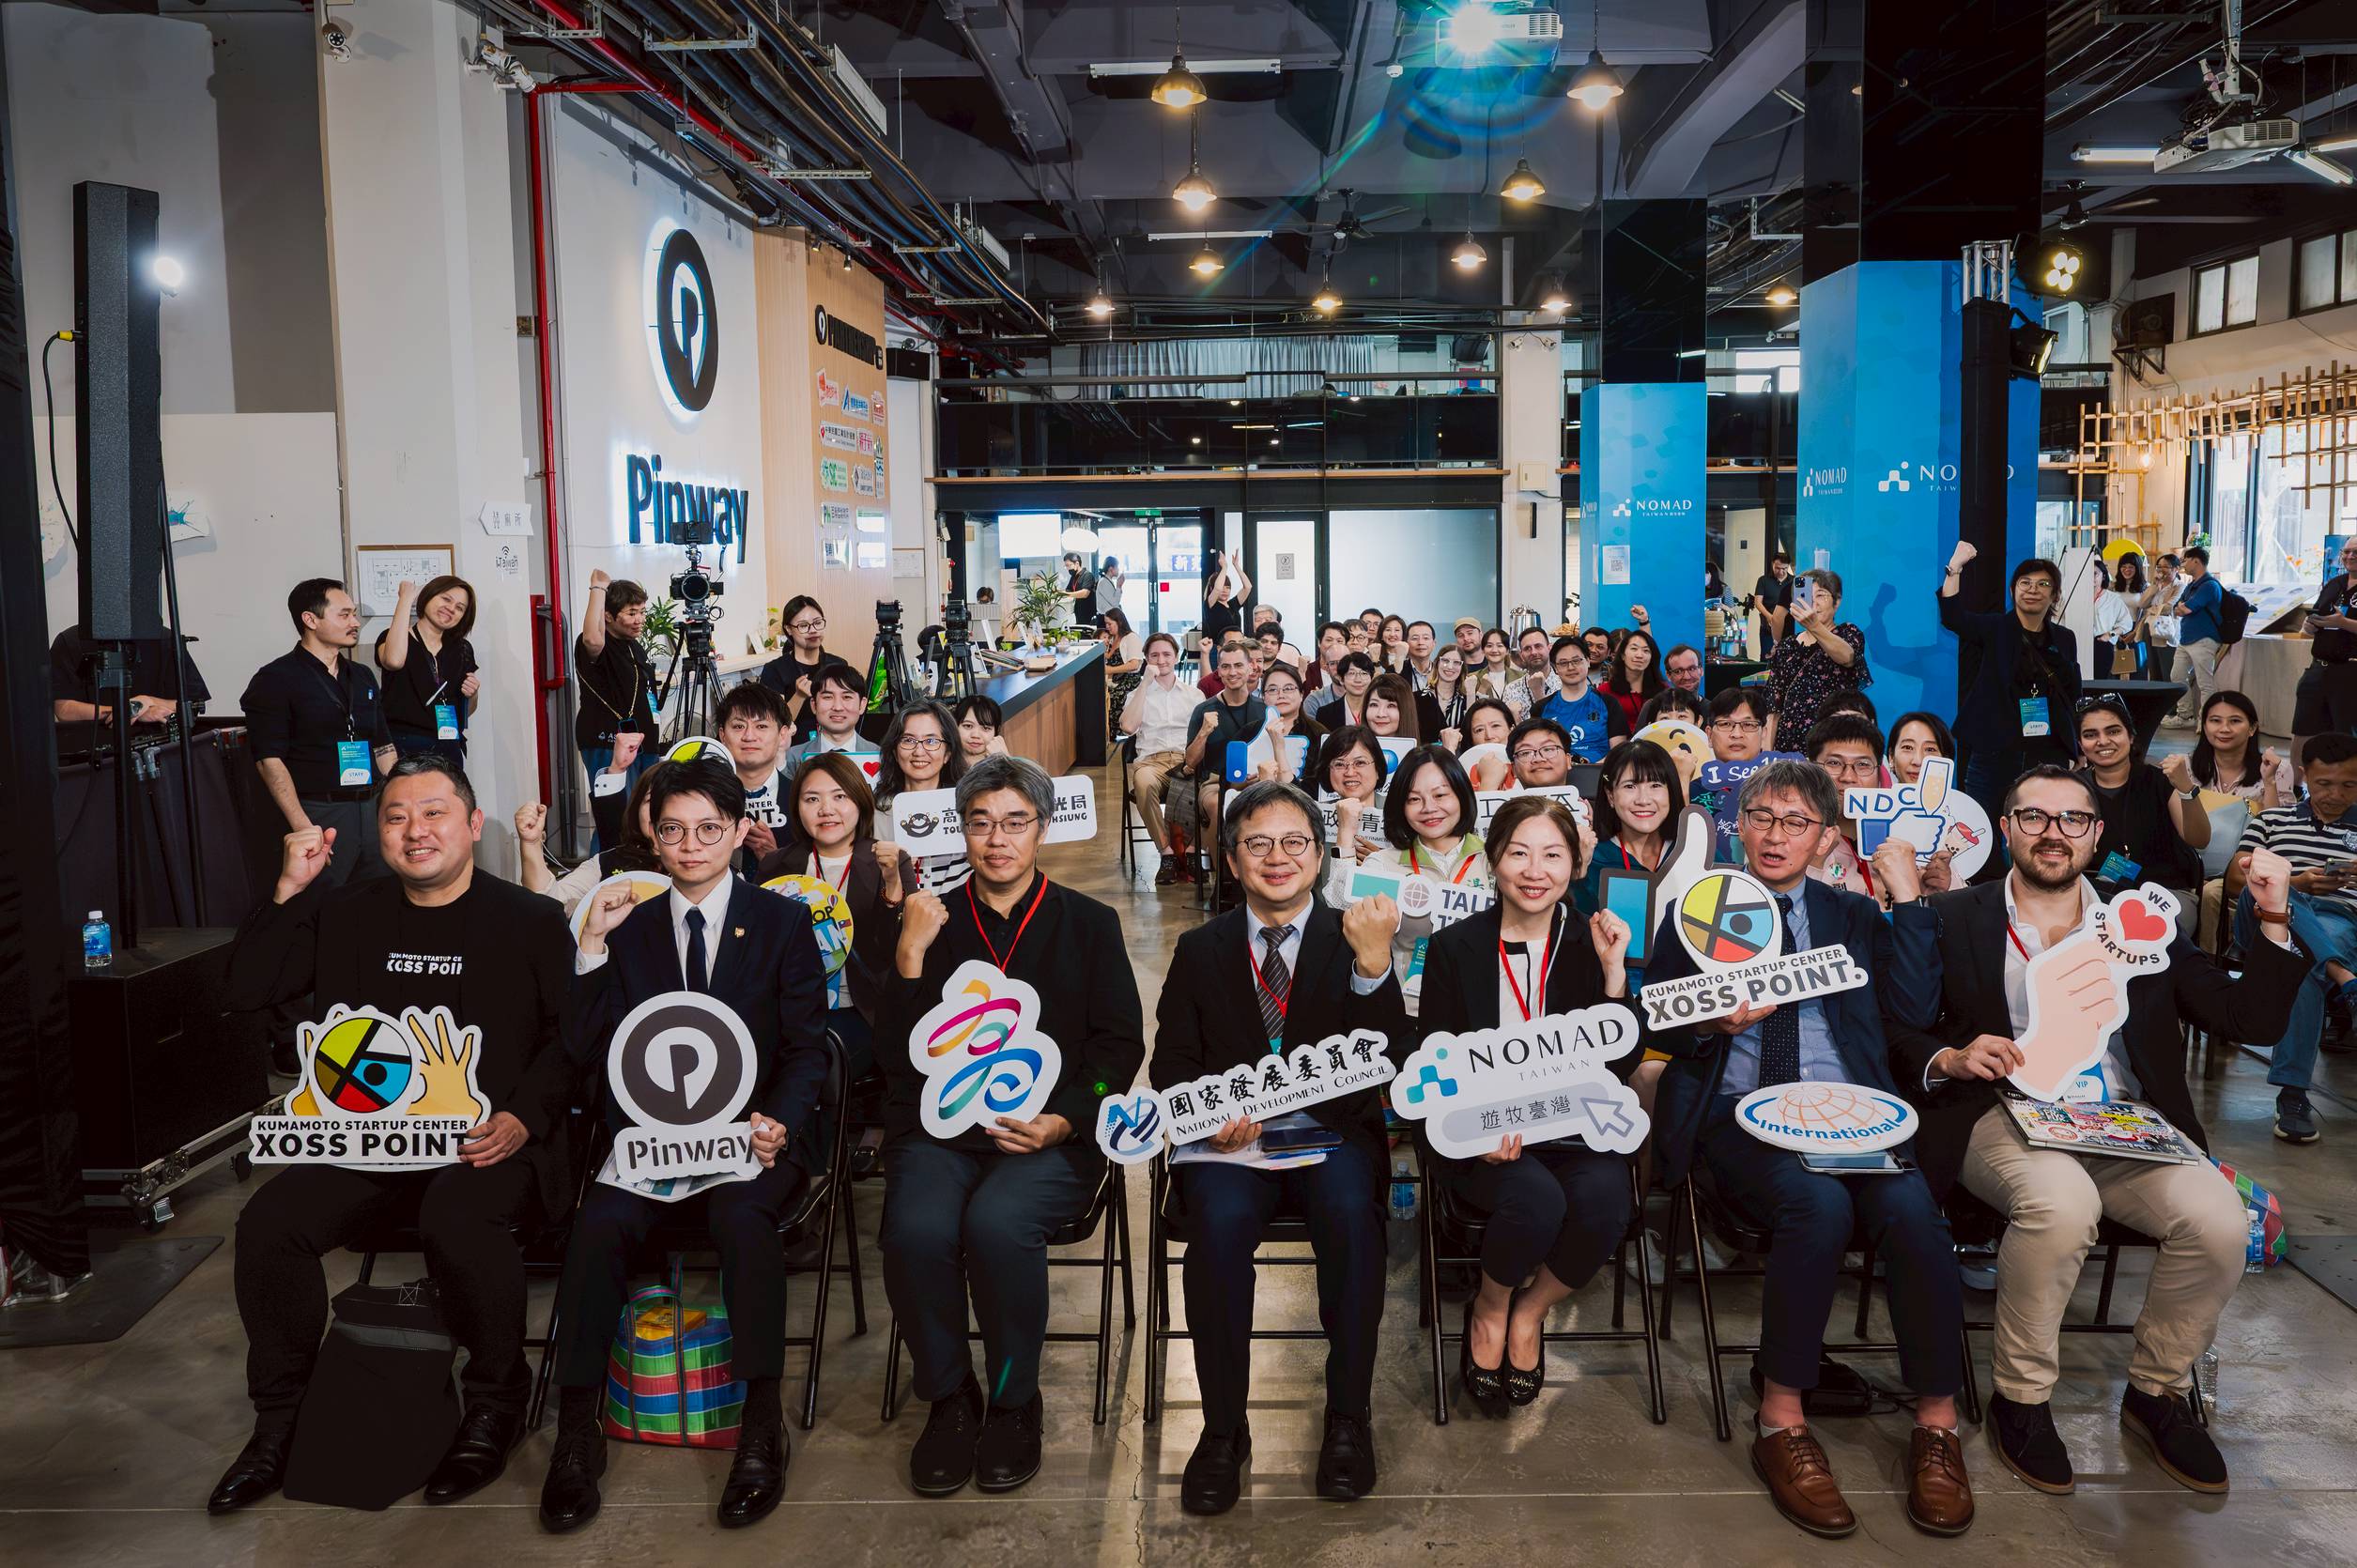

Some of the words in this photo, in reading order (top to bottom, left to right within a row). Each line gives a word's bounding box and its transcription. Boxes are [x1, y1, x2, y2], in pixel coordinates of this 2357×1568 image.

[1815, 467, 1847, 486] NOMAD
[626, 453, 749, 563] Pinway
[1637, 500, 1692, 511] NOMAD
[1708, 766, 1721, 784] I
[1849, 787, 1916, 814] NDC
[1052, 812, 1087, 823] HSIUNG
[2148, 891, 2171, 913] WE
[2095, 911, 2160, 965] STARTUPS
[1647, 974, 1724, 999] KUMAMOTO
[1728, 961, 1786, 982] STARTUP
[1791, 948, 1842, 968] CENTER
[1648, 985, 1738, 1024] XOSS
[1747, 960, 1862, 1003] POINT.
[1469, 1019, 1625, 1073] NOMAD
[1169, 1037, 1379, 1119] 國家發展委員會
[1518, 1059, 1591, 1082] TAIWAN
[1242, 1084, 1325, 1116] DEVELOPMENT
[1334, 1065, 1389, 1089] COUNCIL
[257, 1120, 341, 1130] KUMAMOTO
[345, 1120, 408, 1130] STARTUP
[412, 1120, 468, 1130] CENTER
[1480, 1095, 1571, 1131] 遊牧臺灣
[1760, 1118, 1901, 1140] International
[255, 1132, 347, 1157] XOSS
[362, 1132, 469, 1157] POINT
[627, 1136, 752, 1170] Pinway
